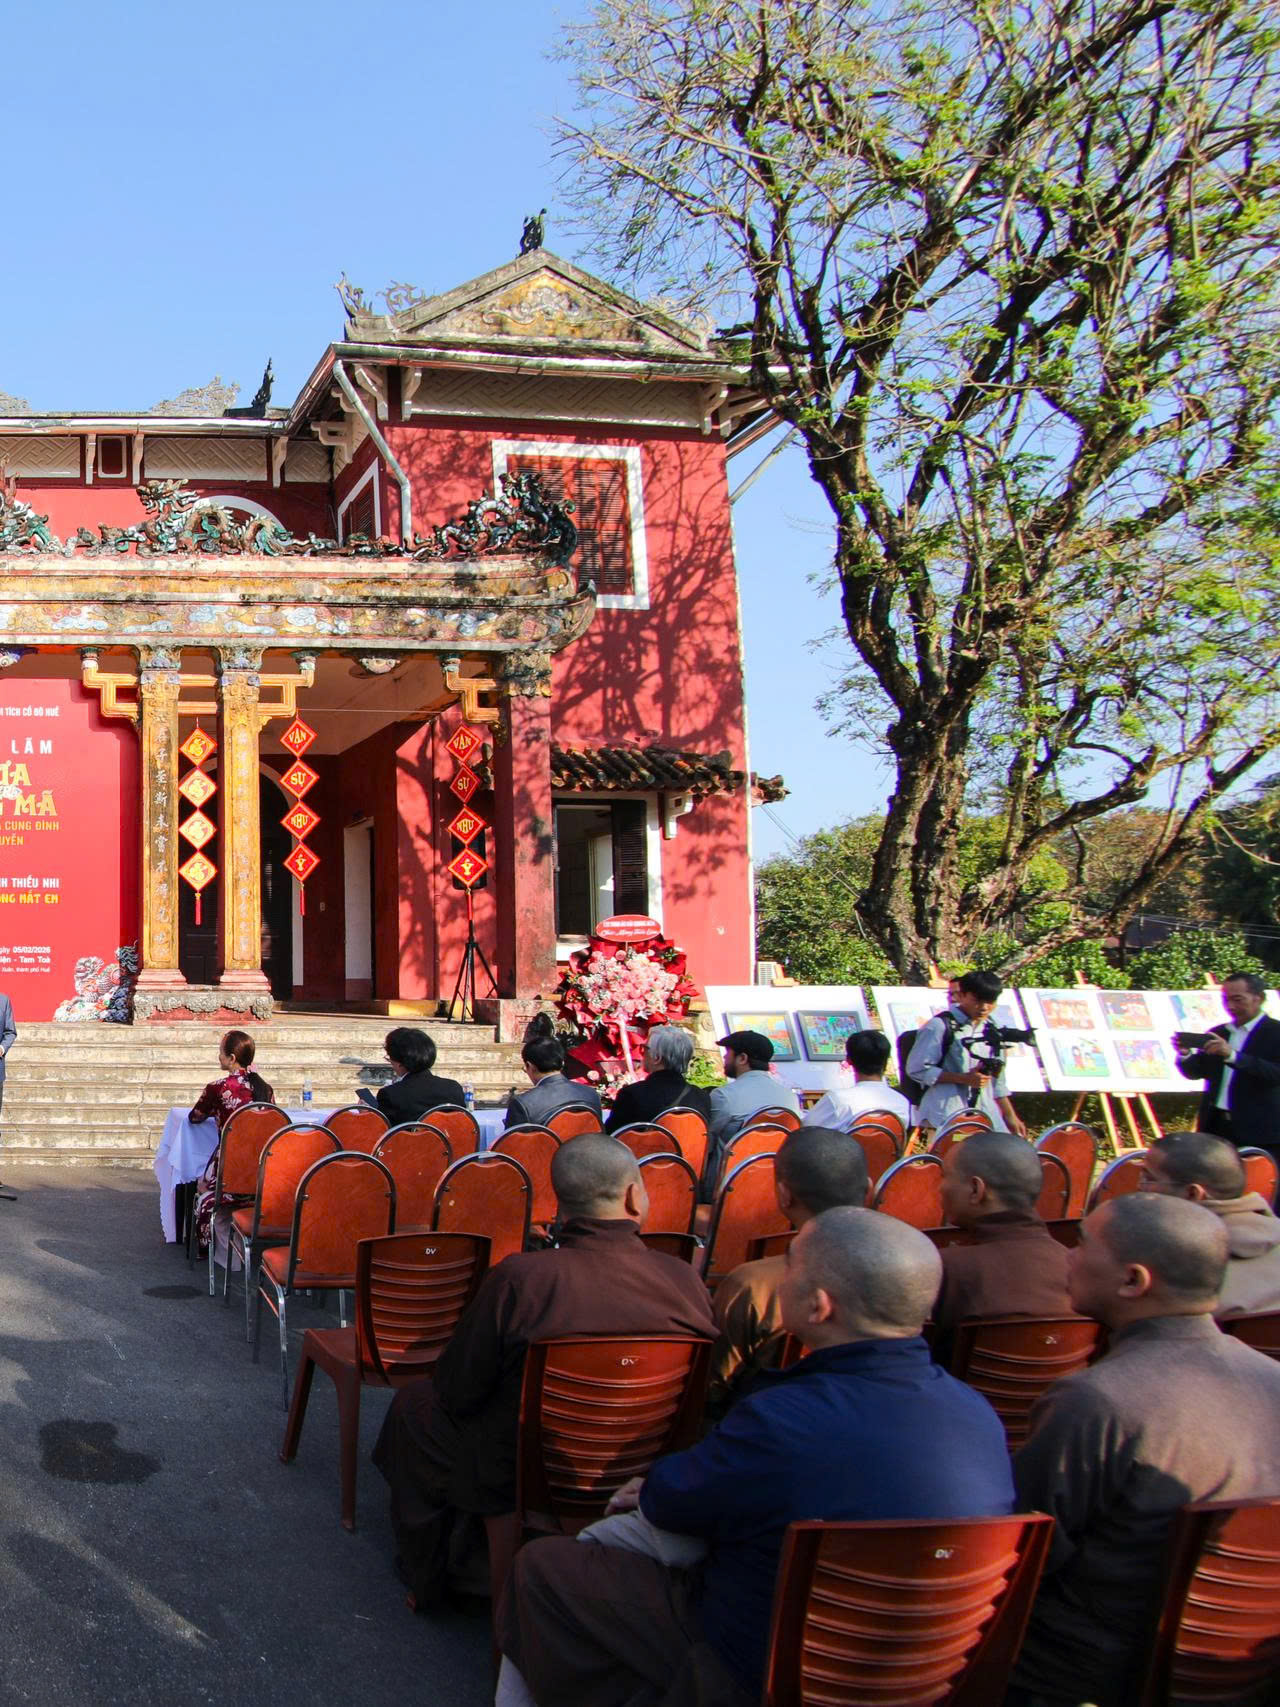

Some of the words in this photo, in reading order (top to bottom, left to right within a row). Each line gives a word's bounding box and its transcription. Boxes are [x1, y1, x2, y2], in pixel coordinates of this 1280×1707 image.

[10, 736, 53, 755] LÃM
[13, 789, 58, 816] MÃ
[4, 820, 32, 831] CUNG
[42, 877, 60, 888] NHI
[44, 893, 59, 904] EM
[18, 955, 35, 963] Tam
[425, 1247, 437, 1255] DV
